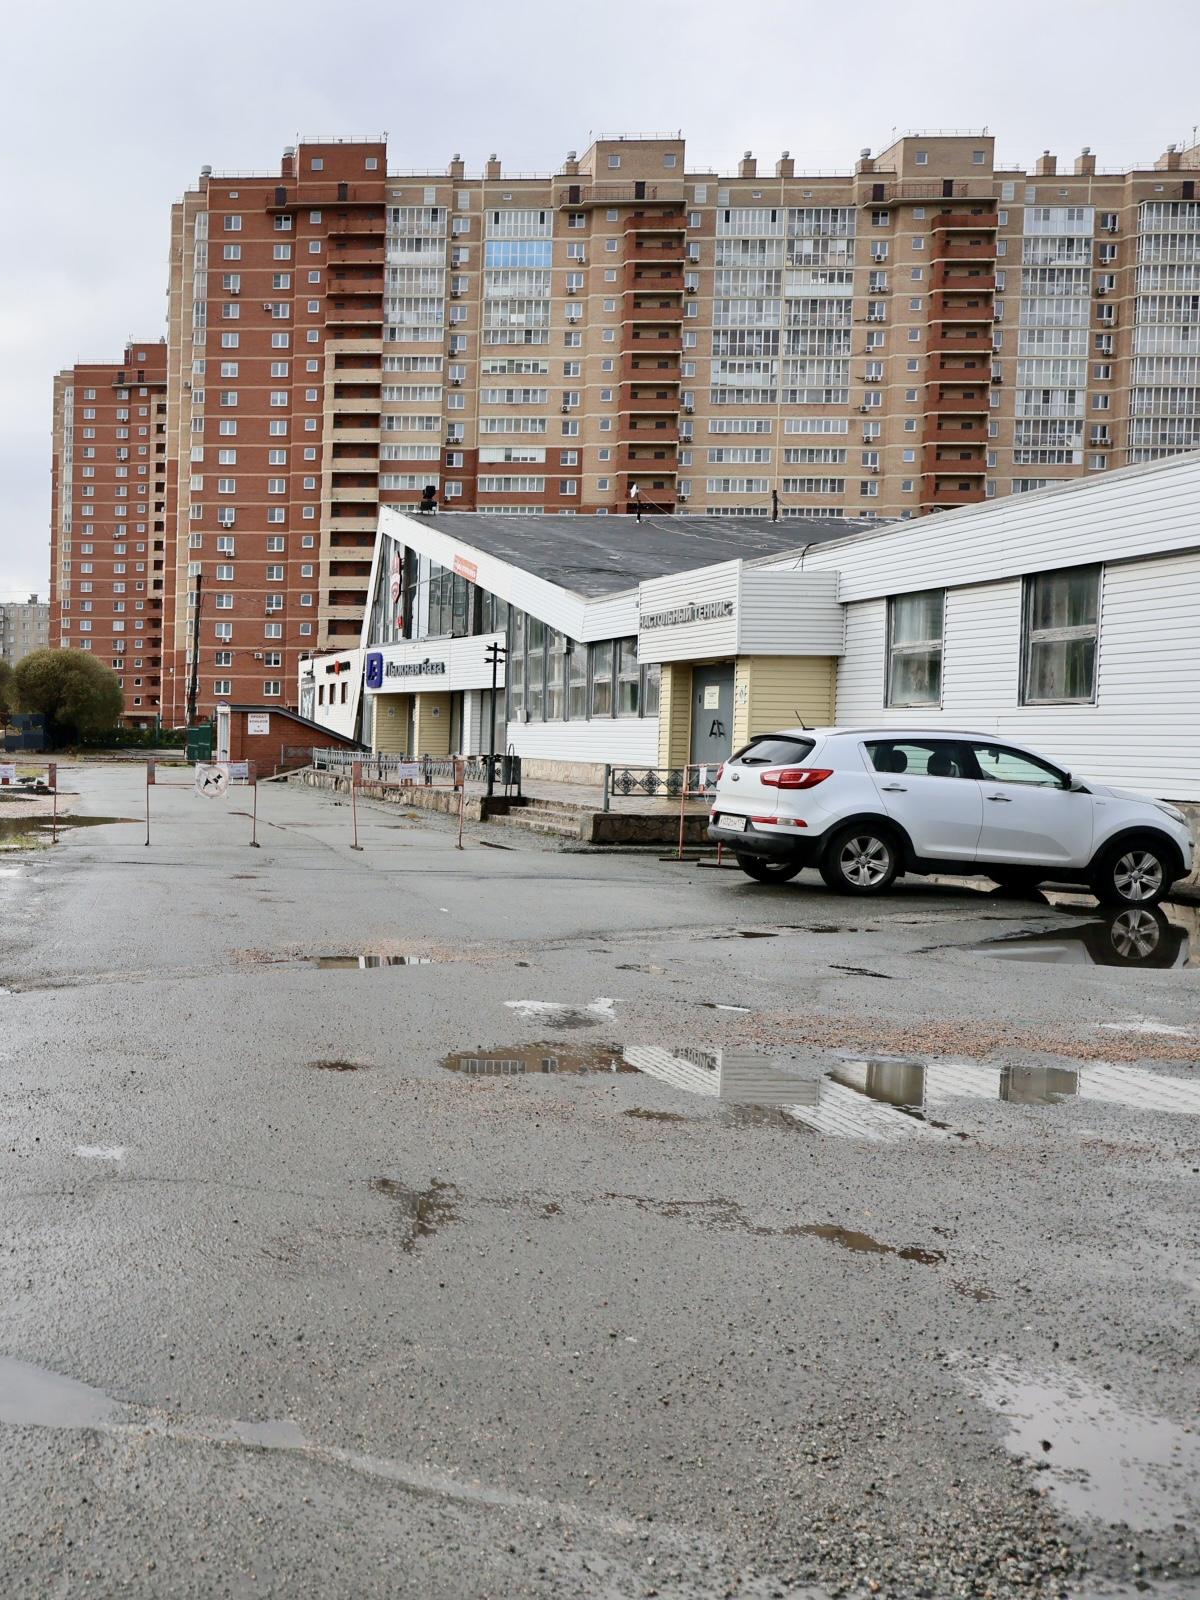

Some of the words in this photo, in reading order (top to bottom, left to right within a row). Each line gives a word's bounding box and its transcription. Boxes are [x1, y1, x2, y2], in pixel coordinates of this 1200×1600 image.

[640, 602, 694, 629] НАСТОЛЬНЫЙ
[694, 601, 732, 621] ТЕННИС
[386, 661, 421, 676] Лыжная
[422, 658, 445, 674] база
